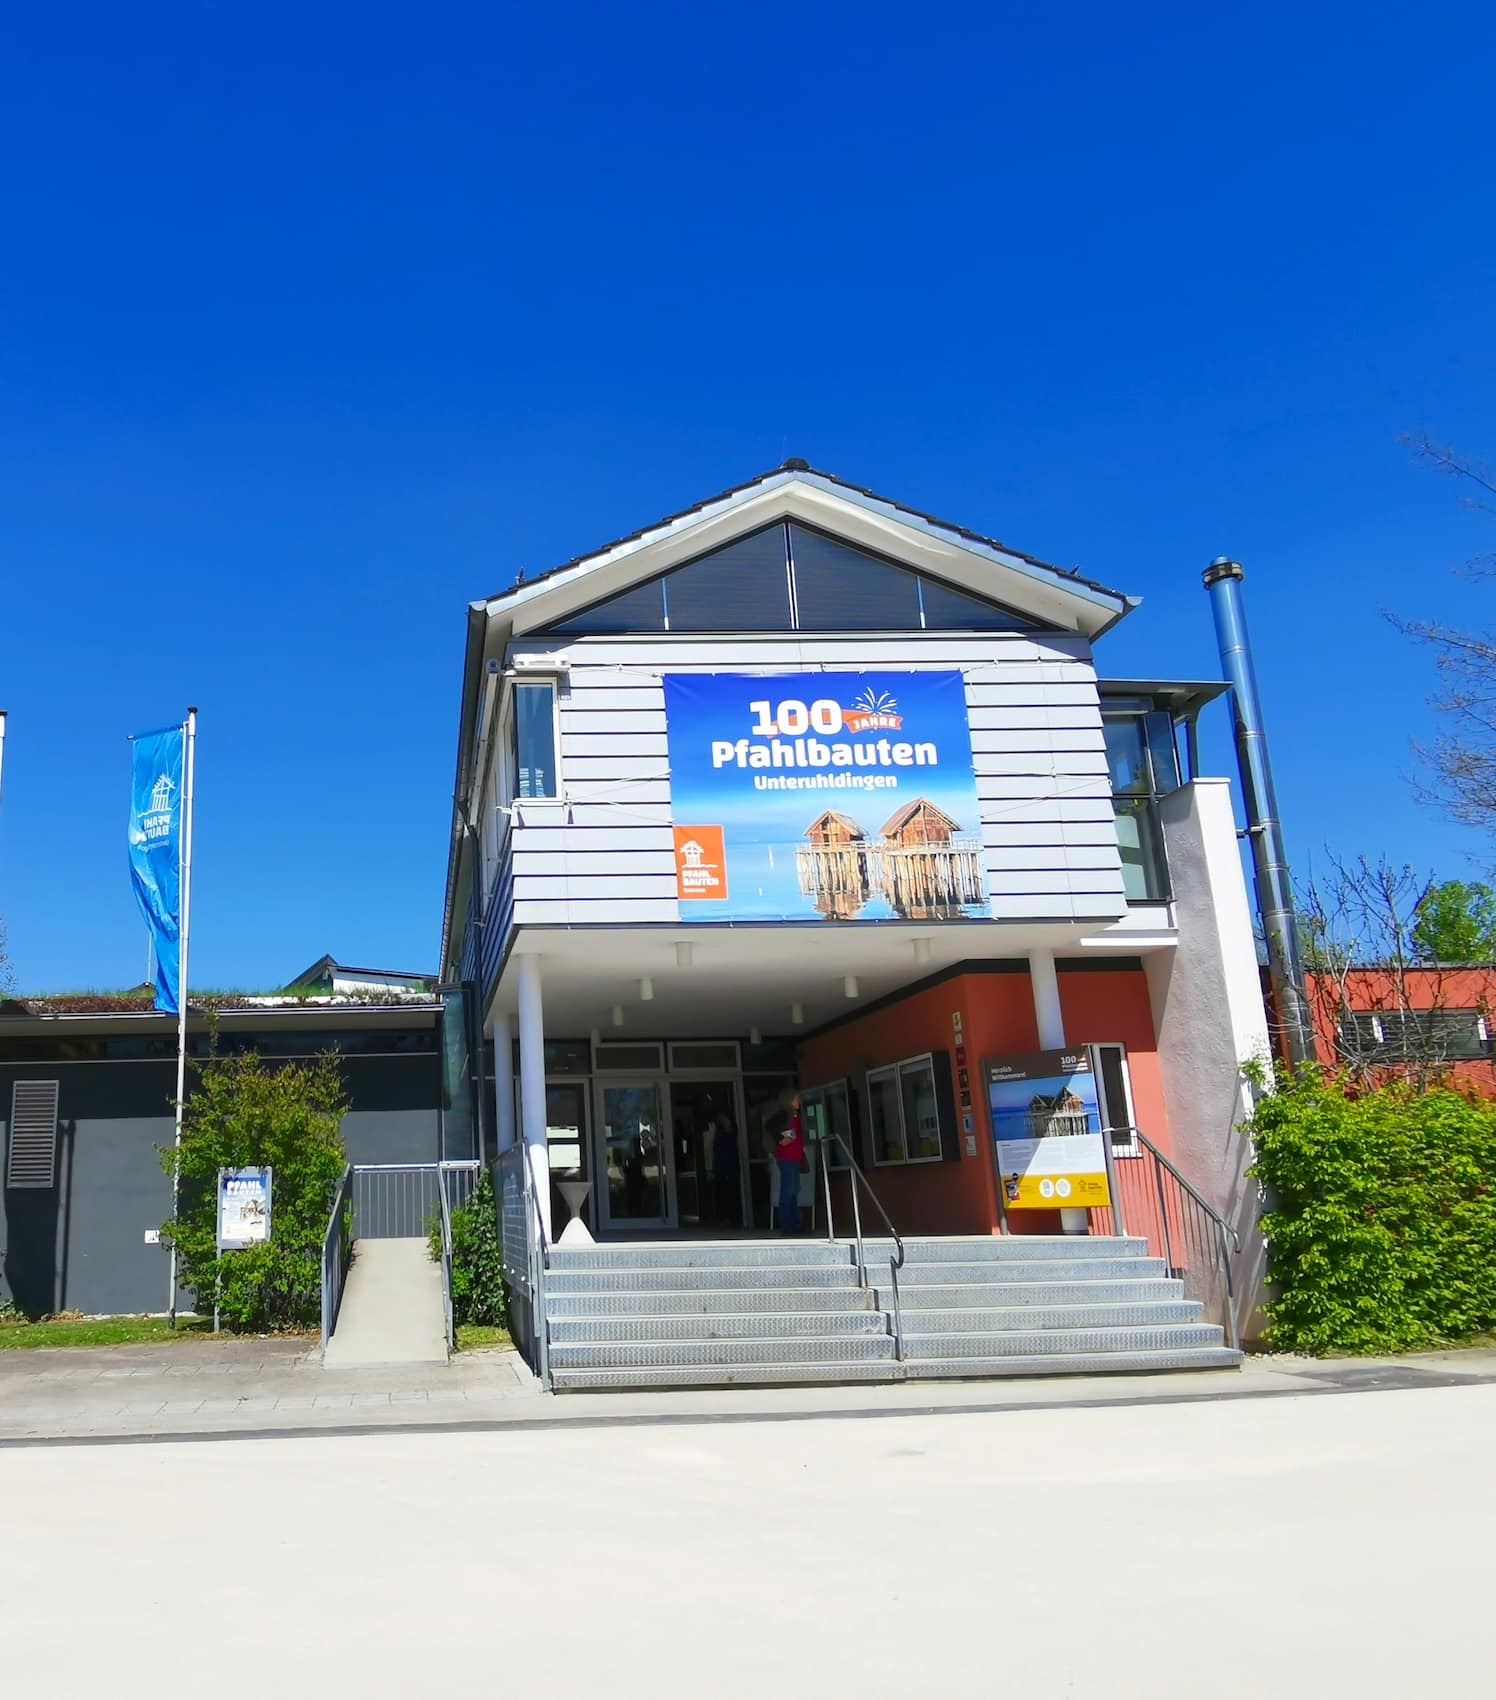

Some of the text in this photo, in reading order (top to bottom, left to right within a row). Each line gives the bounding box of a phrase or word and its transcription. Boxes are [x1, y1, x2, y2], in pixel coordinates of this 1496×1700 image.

[750, 699, 897, 736] 100 JAHRE
[711, 738, 938, 769] Pfahlbauten
[754, 774, 898, 791] Unteruhldingen
[1060, 1055, 1077, 1065] 100
[227, 1181, 261, 1190] PFAHL
